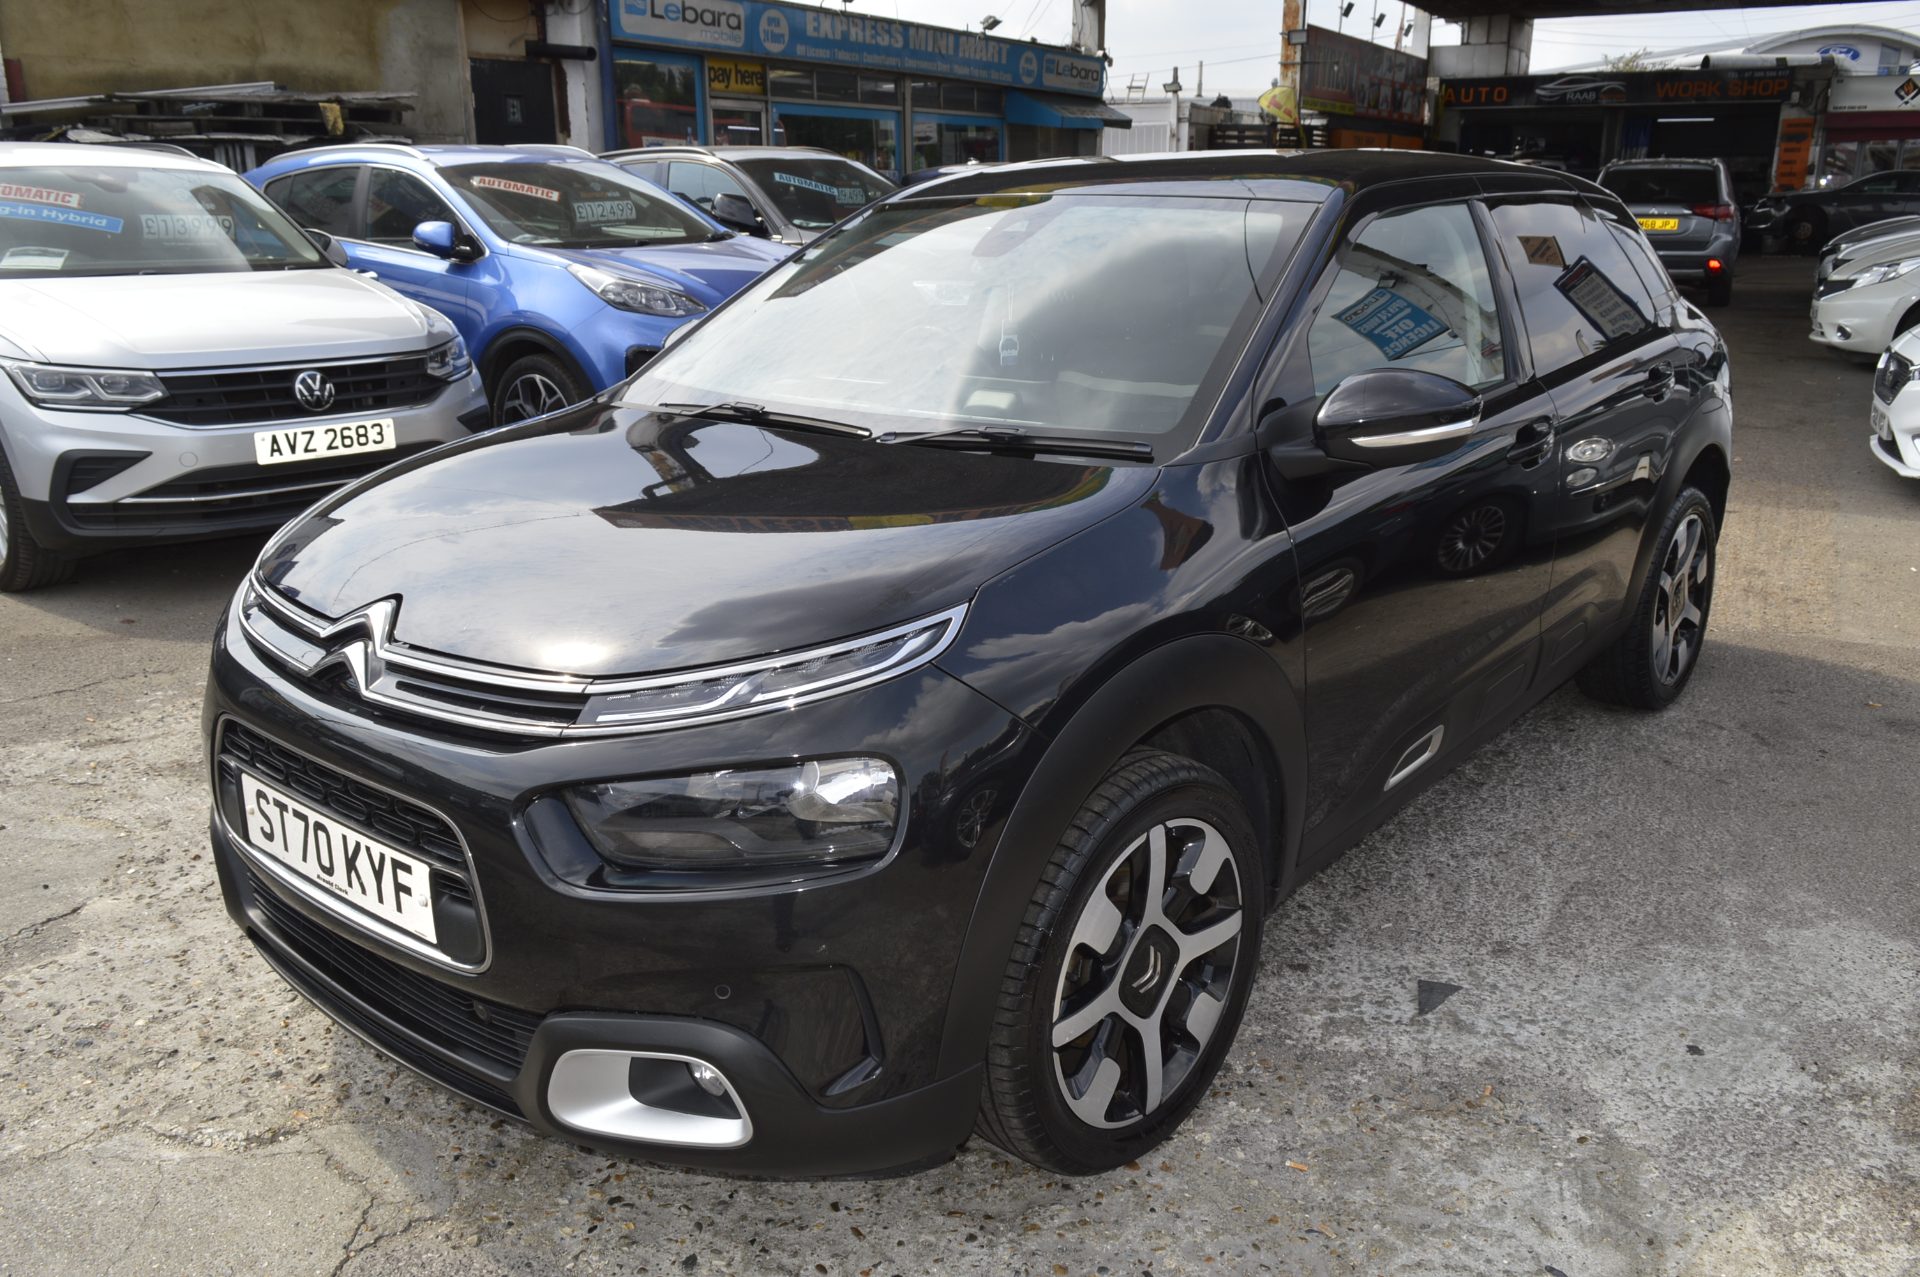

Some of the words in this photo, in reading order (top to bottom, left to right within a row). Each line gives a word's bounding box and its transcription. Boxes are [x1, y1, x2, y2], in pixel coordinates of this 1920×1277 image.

[650, 0, 742, 31] Lebara
[700, 29, 742, 44] mobile
[806, 11, 903, 48] EXPRESS
[909, 26, 955, 55] MINI
[958, 34, 1009, 65] MART
[708, 64, 732, 88] pay
[735, 64, 764, 86] here
[1055, 59, 1099, 82] Lebara
[1444, 86, 1508, 105] AUTO
[1656, 80, 1722, 99] WORK
[1727, 79, 1790, 97] SHOP
[478, 177, 555, 200] AUTOMATIC
[777, 173, 836, 194] AUTOMATIC
[42, 208, 108, 227] Hybrid
[576, 203, 634, 220] £12499
[1658, 219, 1677, 229] JPJ
[270, 430, 317, 458] AVZ
[324, 423, 385, 451] 2683
[255, 788, 335, 878] ST70
[341, 834, 413, 914] KYF
[316, 874, 334, 887] Arnold
[334, 884, 349, 896] Clark
